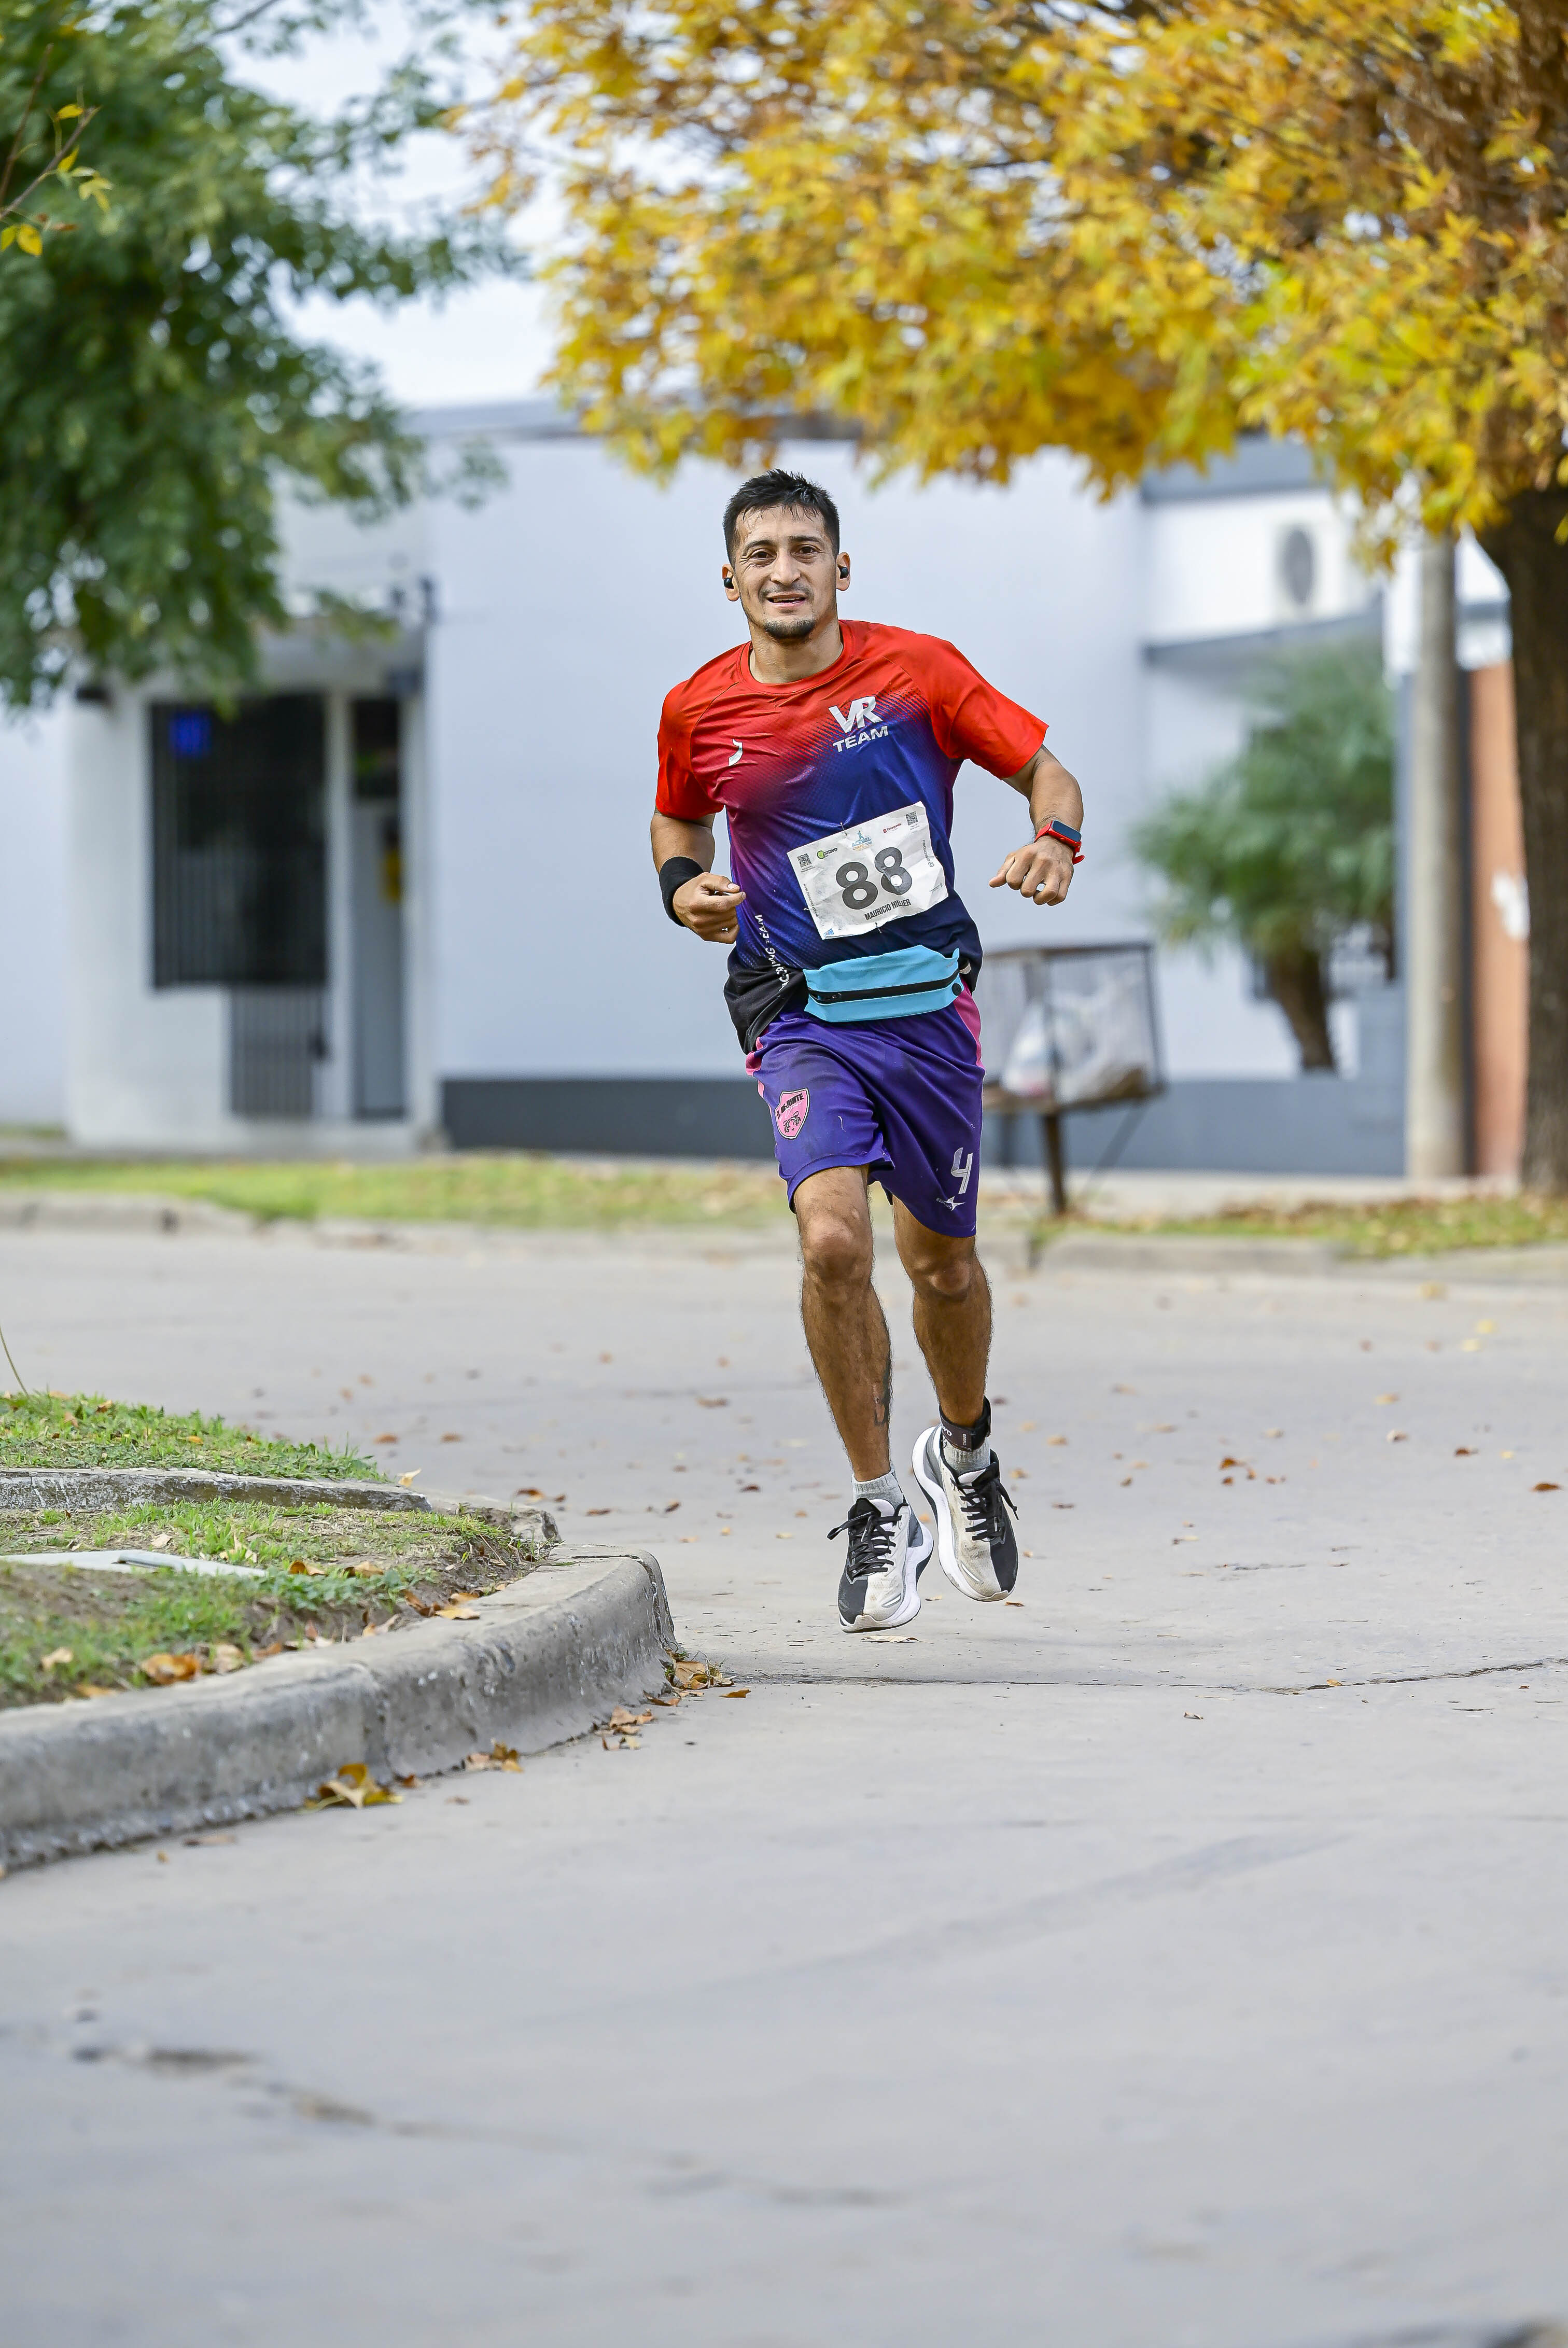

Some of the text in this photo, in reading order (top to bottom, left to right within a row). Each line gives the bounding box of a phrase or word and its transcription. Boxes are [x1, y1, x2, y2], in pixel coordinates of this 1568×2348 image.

[828, 696, 884, 733] VR
[833, 726, 888, 752] TEAM
[835, 847, 913, 910] 88
[864, 903, 891, 920] MAURICIO
[951, 1147, 973, 1194] 4
